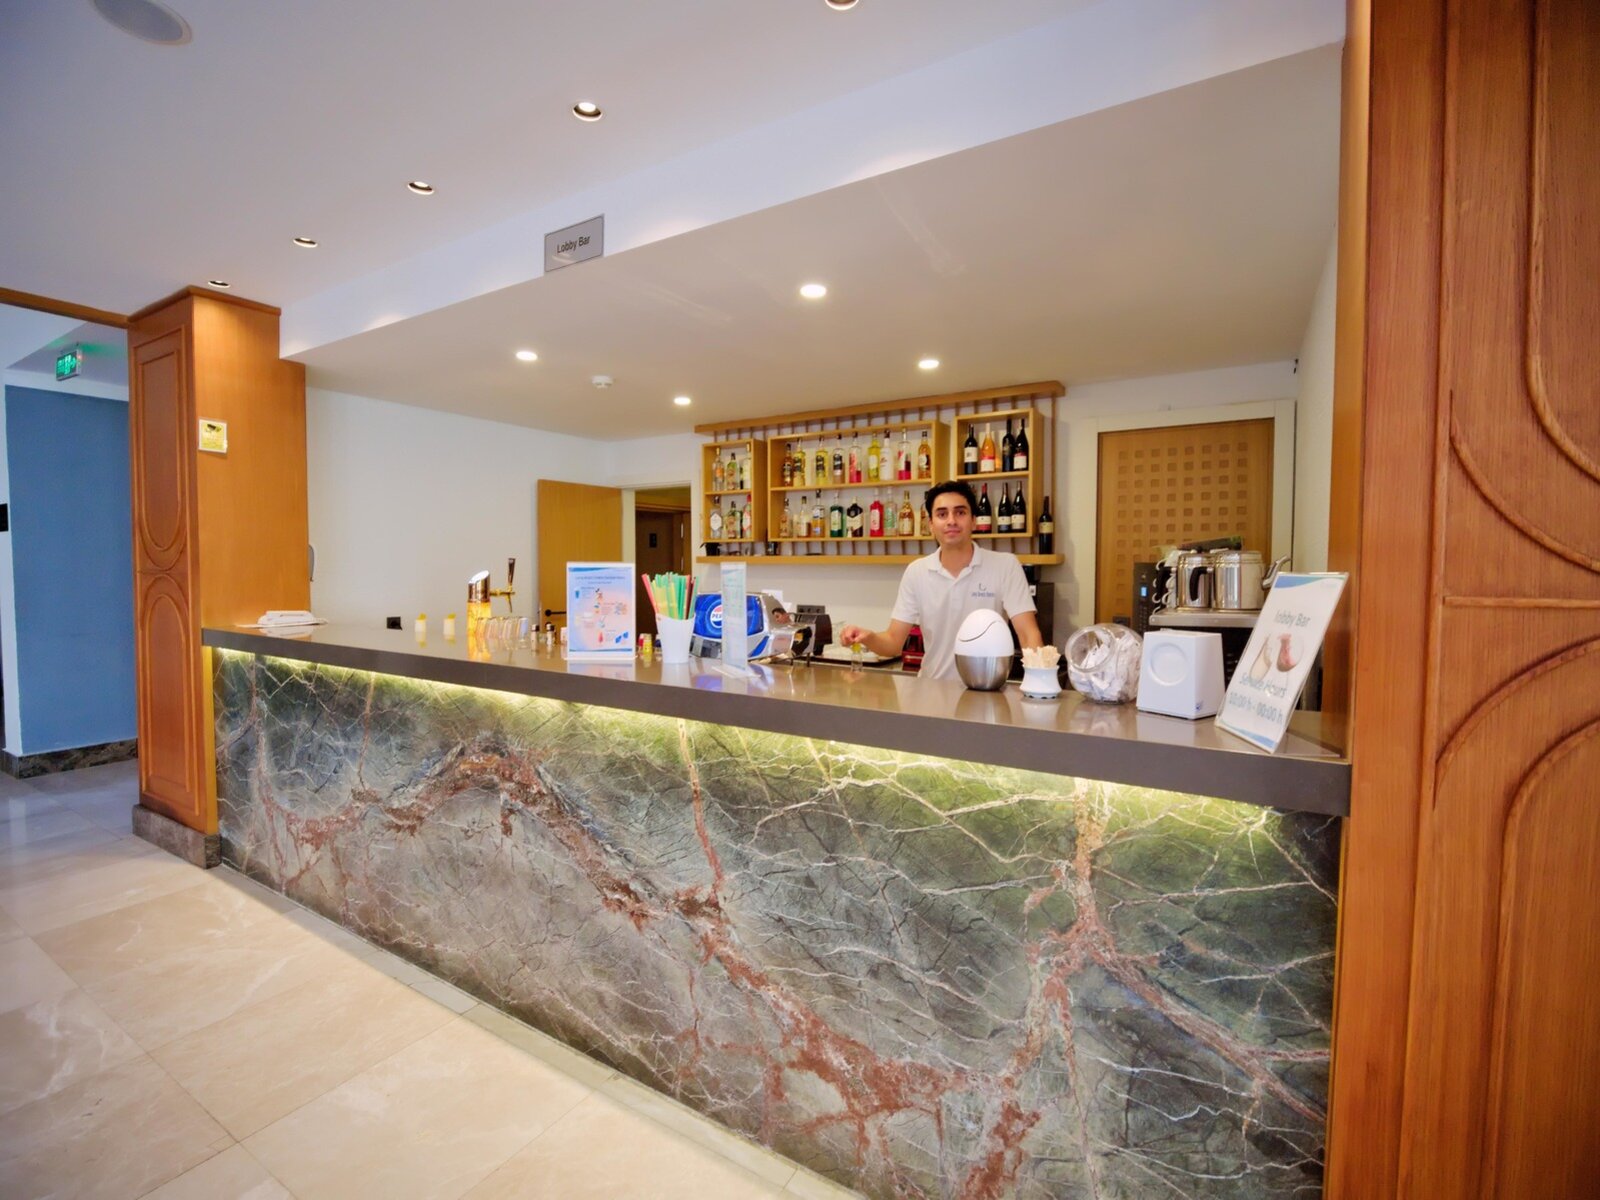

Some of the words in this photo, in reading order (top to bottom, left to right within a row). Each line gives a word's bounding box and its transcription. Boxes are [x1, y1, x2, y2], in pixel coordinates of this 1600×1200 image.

[557, 240, 577, 253] Lobby
[579, 236, 590, 246] Bar
[1296, 612, 1311, 627] Bar
[1263, 679, 1287, 699] Hours
